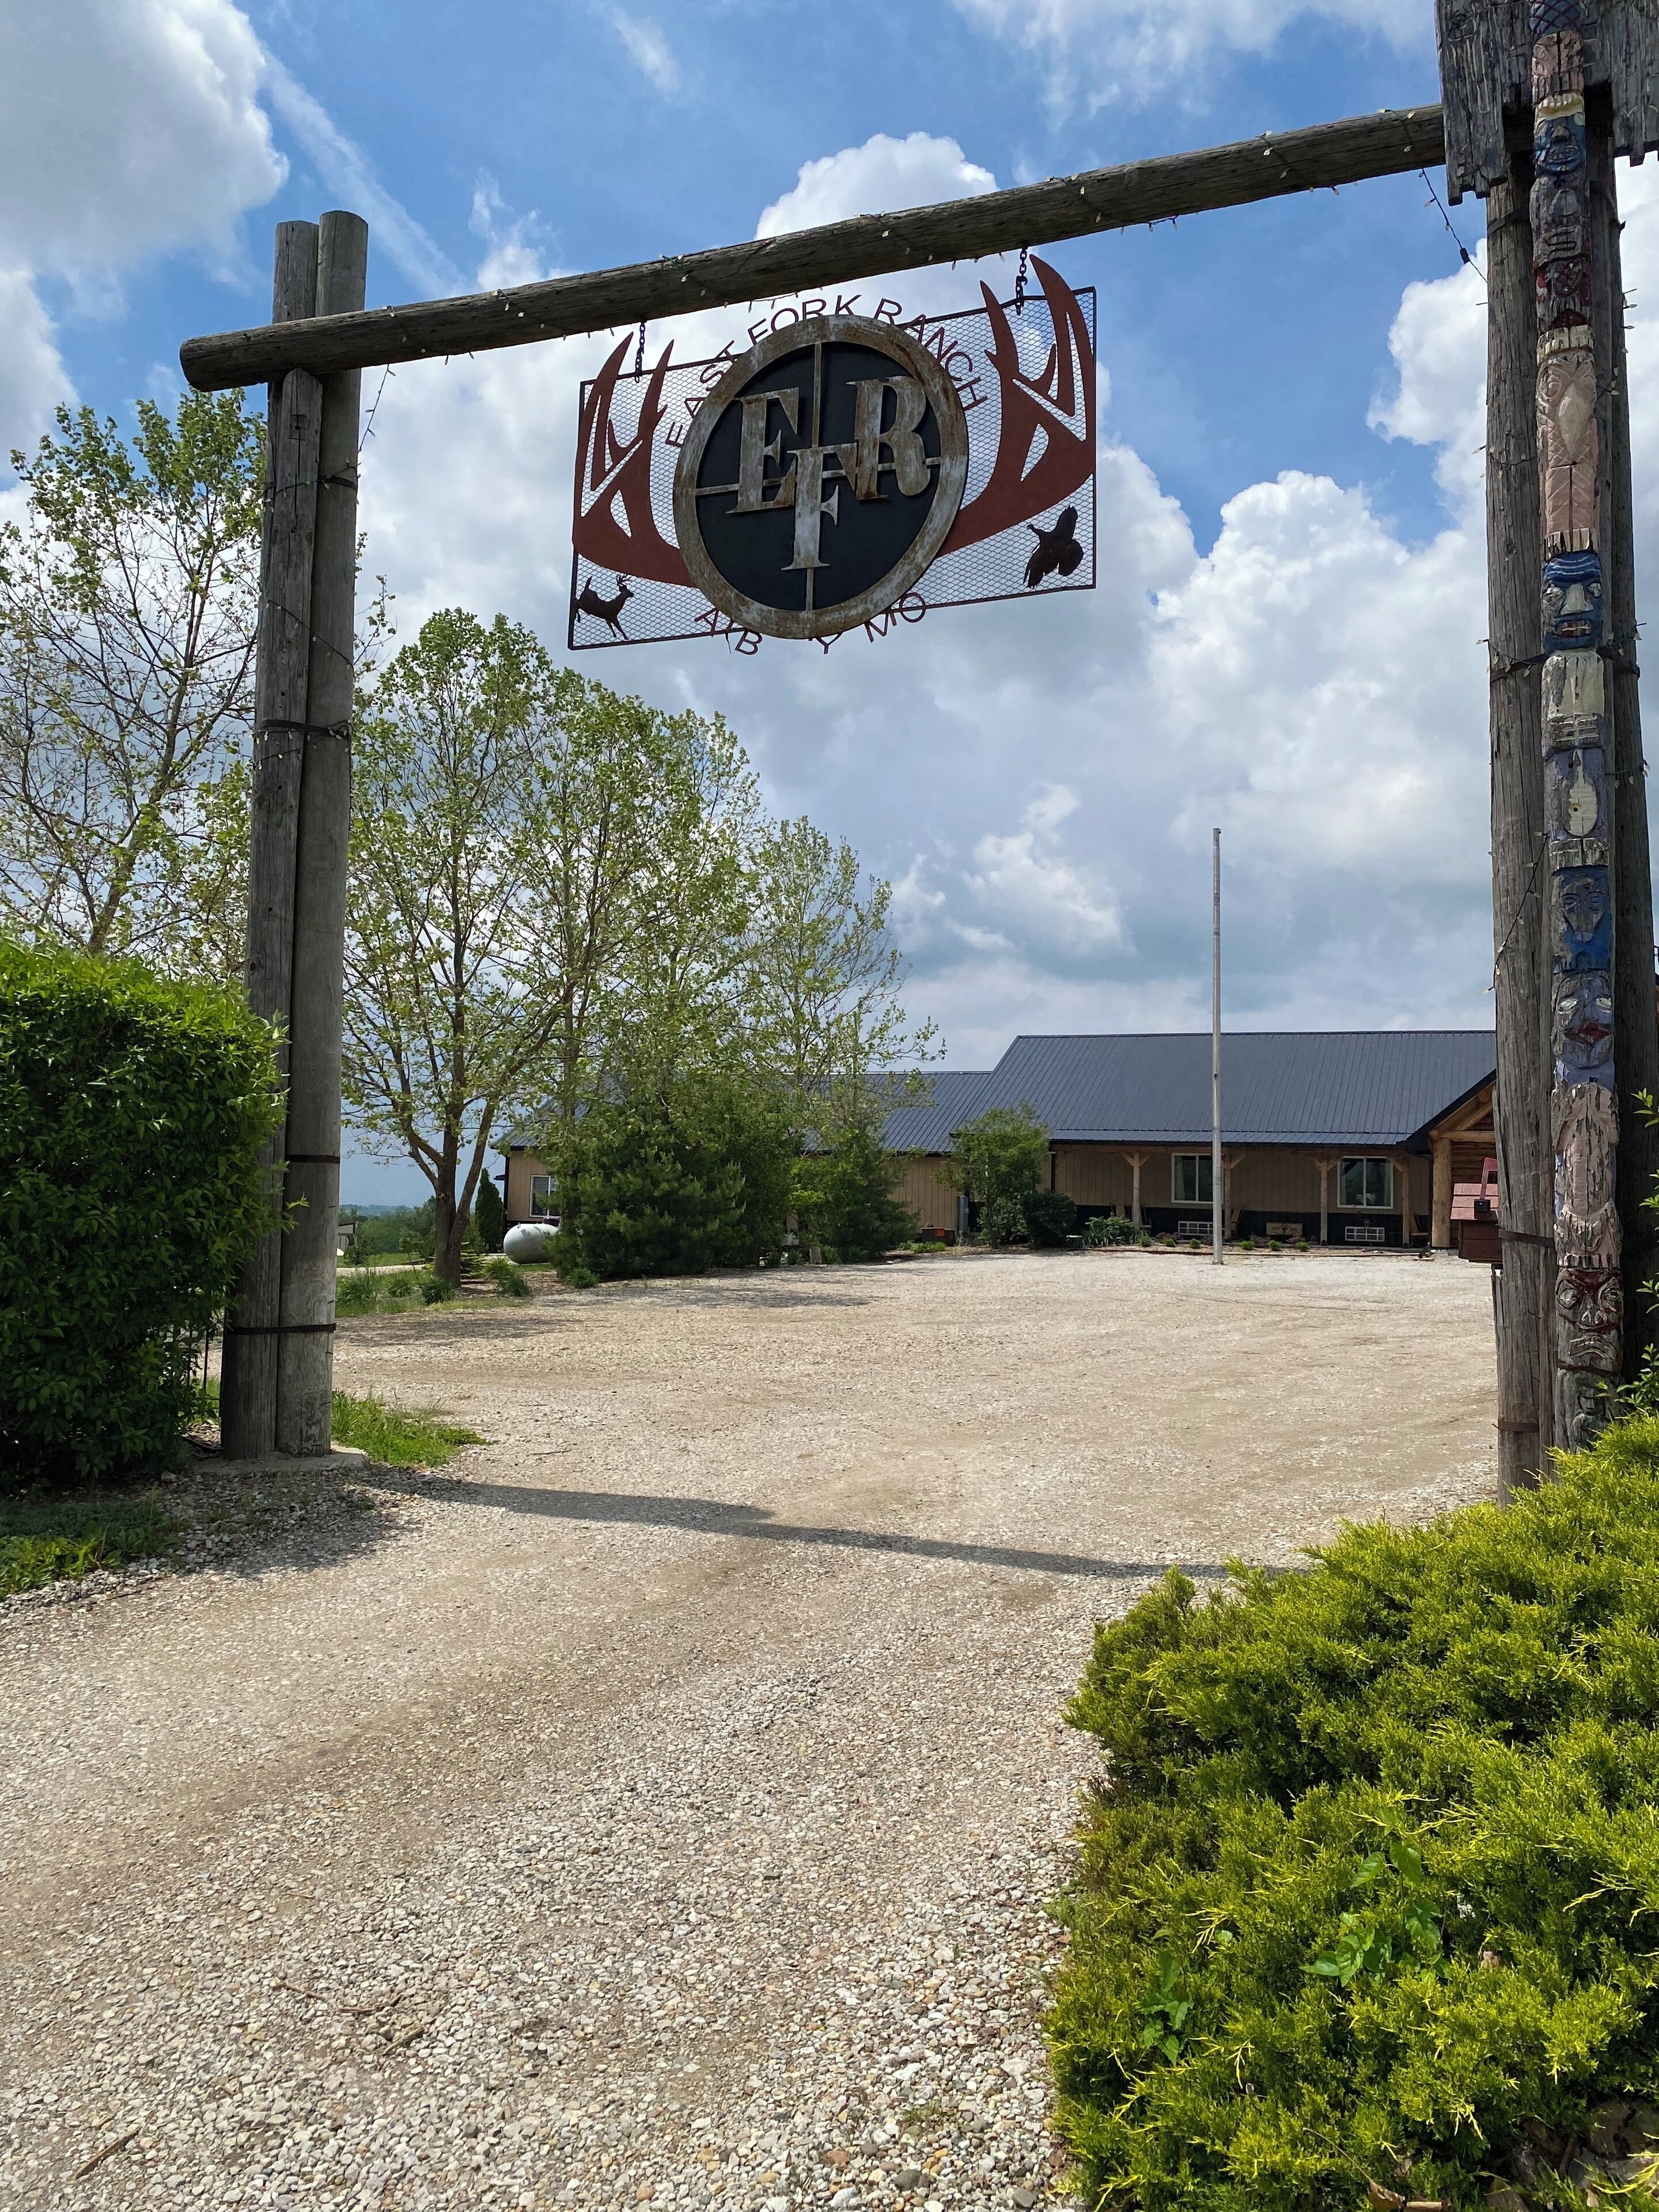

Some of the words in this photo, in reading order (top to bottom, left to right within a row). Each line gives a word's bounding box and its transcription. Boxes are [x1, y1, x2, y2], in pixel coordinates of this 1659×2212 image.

[665, 340, 735, 448] EAST
[748, 294, 862, 346] FORK
[873, 298, 988, 411] RANCH
